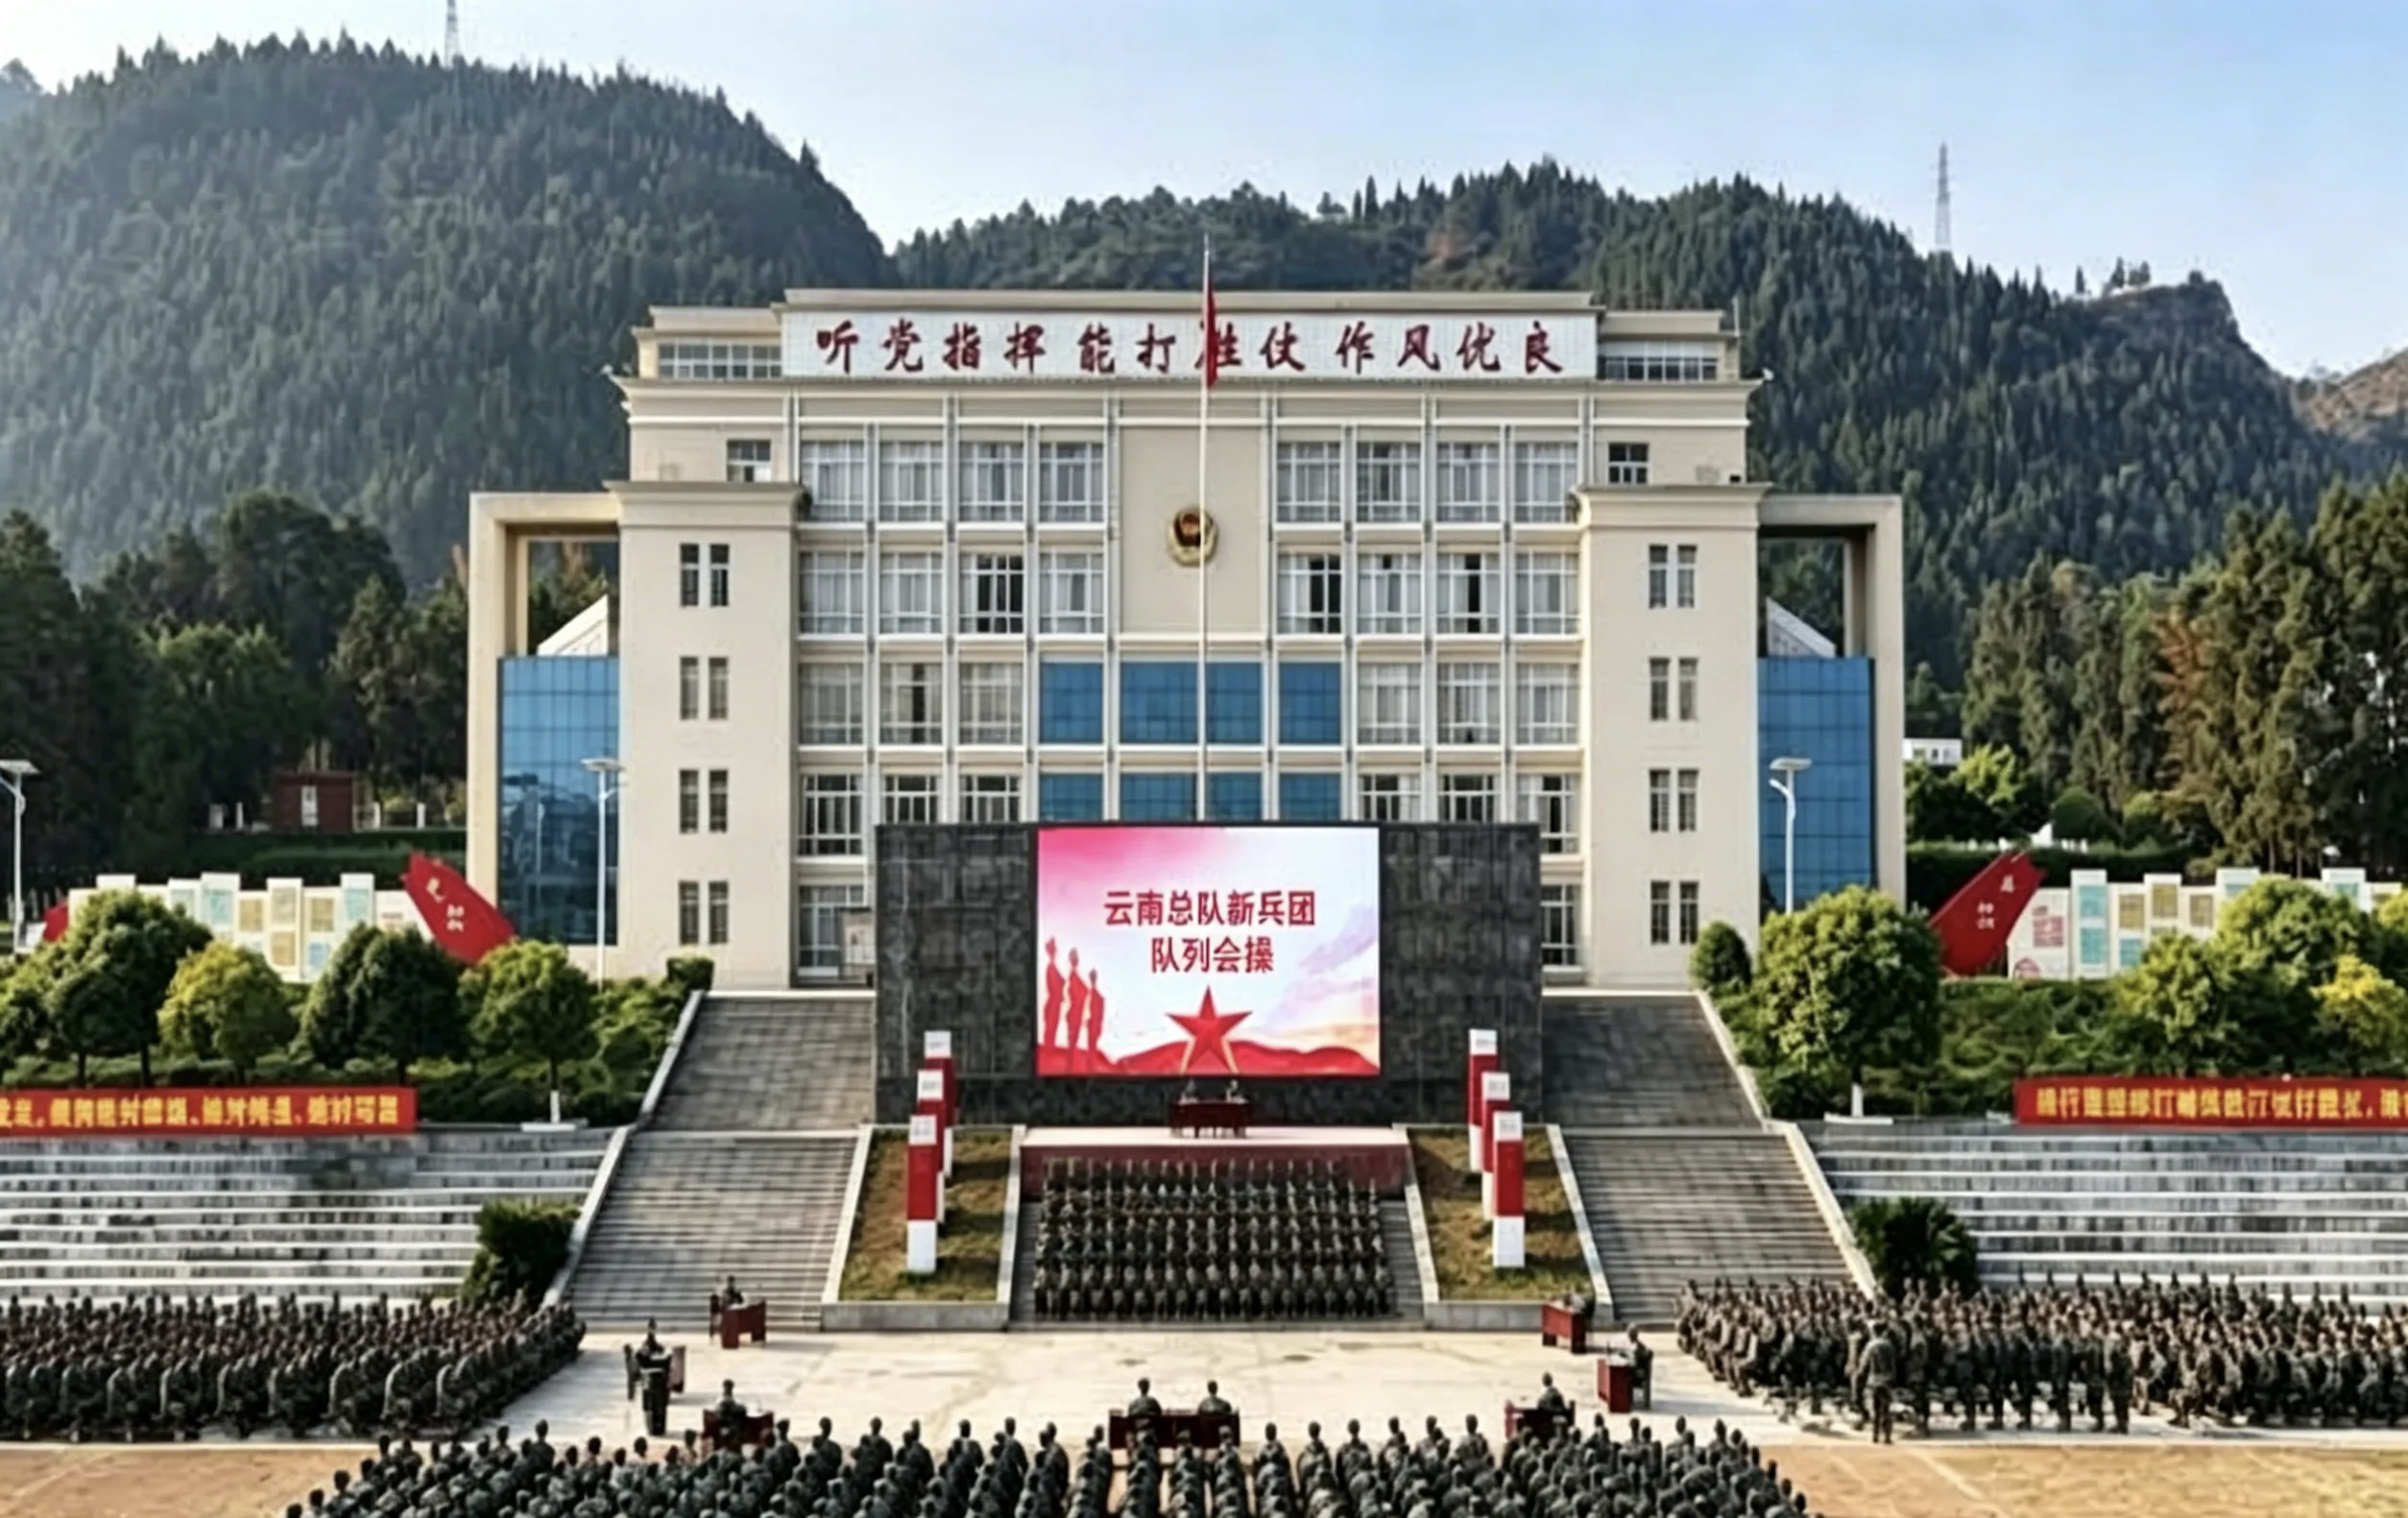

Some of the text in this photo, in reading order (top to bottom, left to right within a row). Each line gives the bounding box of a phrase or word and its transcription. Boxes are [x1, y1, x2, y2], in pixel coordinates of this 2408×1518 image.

[816, 319, 1046, 373] 听党指挥
[1335, 320, 1563, 373] 作风优良
[1104, 889, 1315, 927] 云南总队新兵团
[1151, 935, 1274, 974] 队列会操
